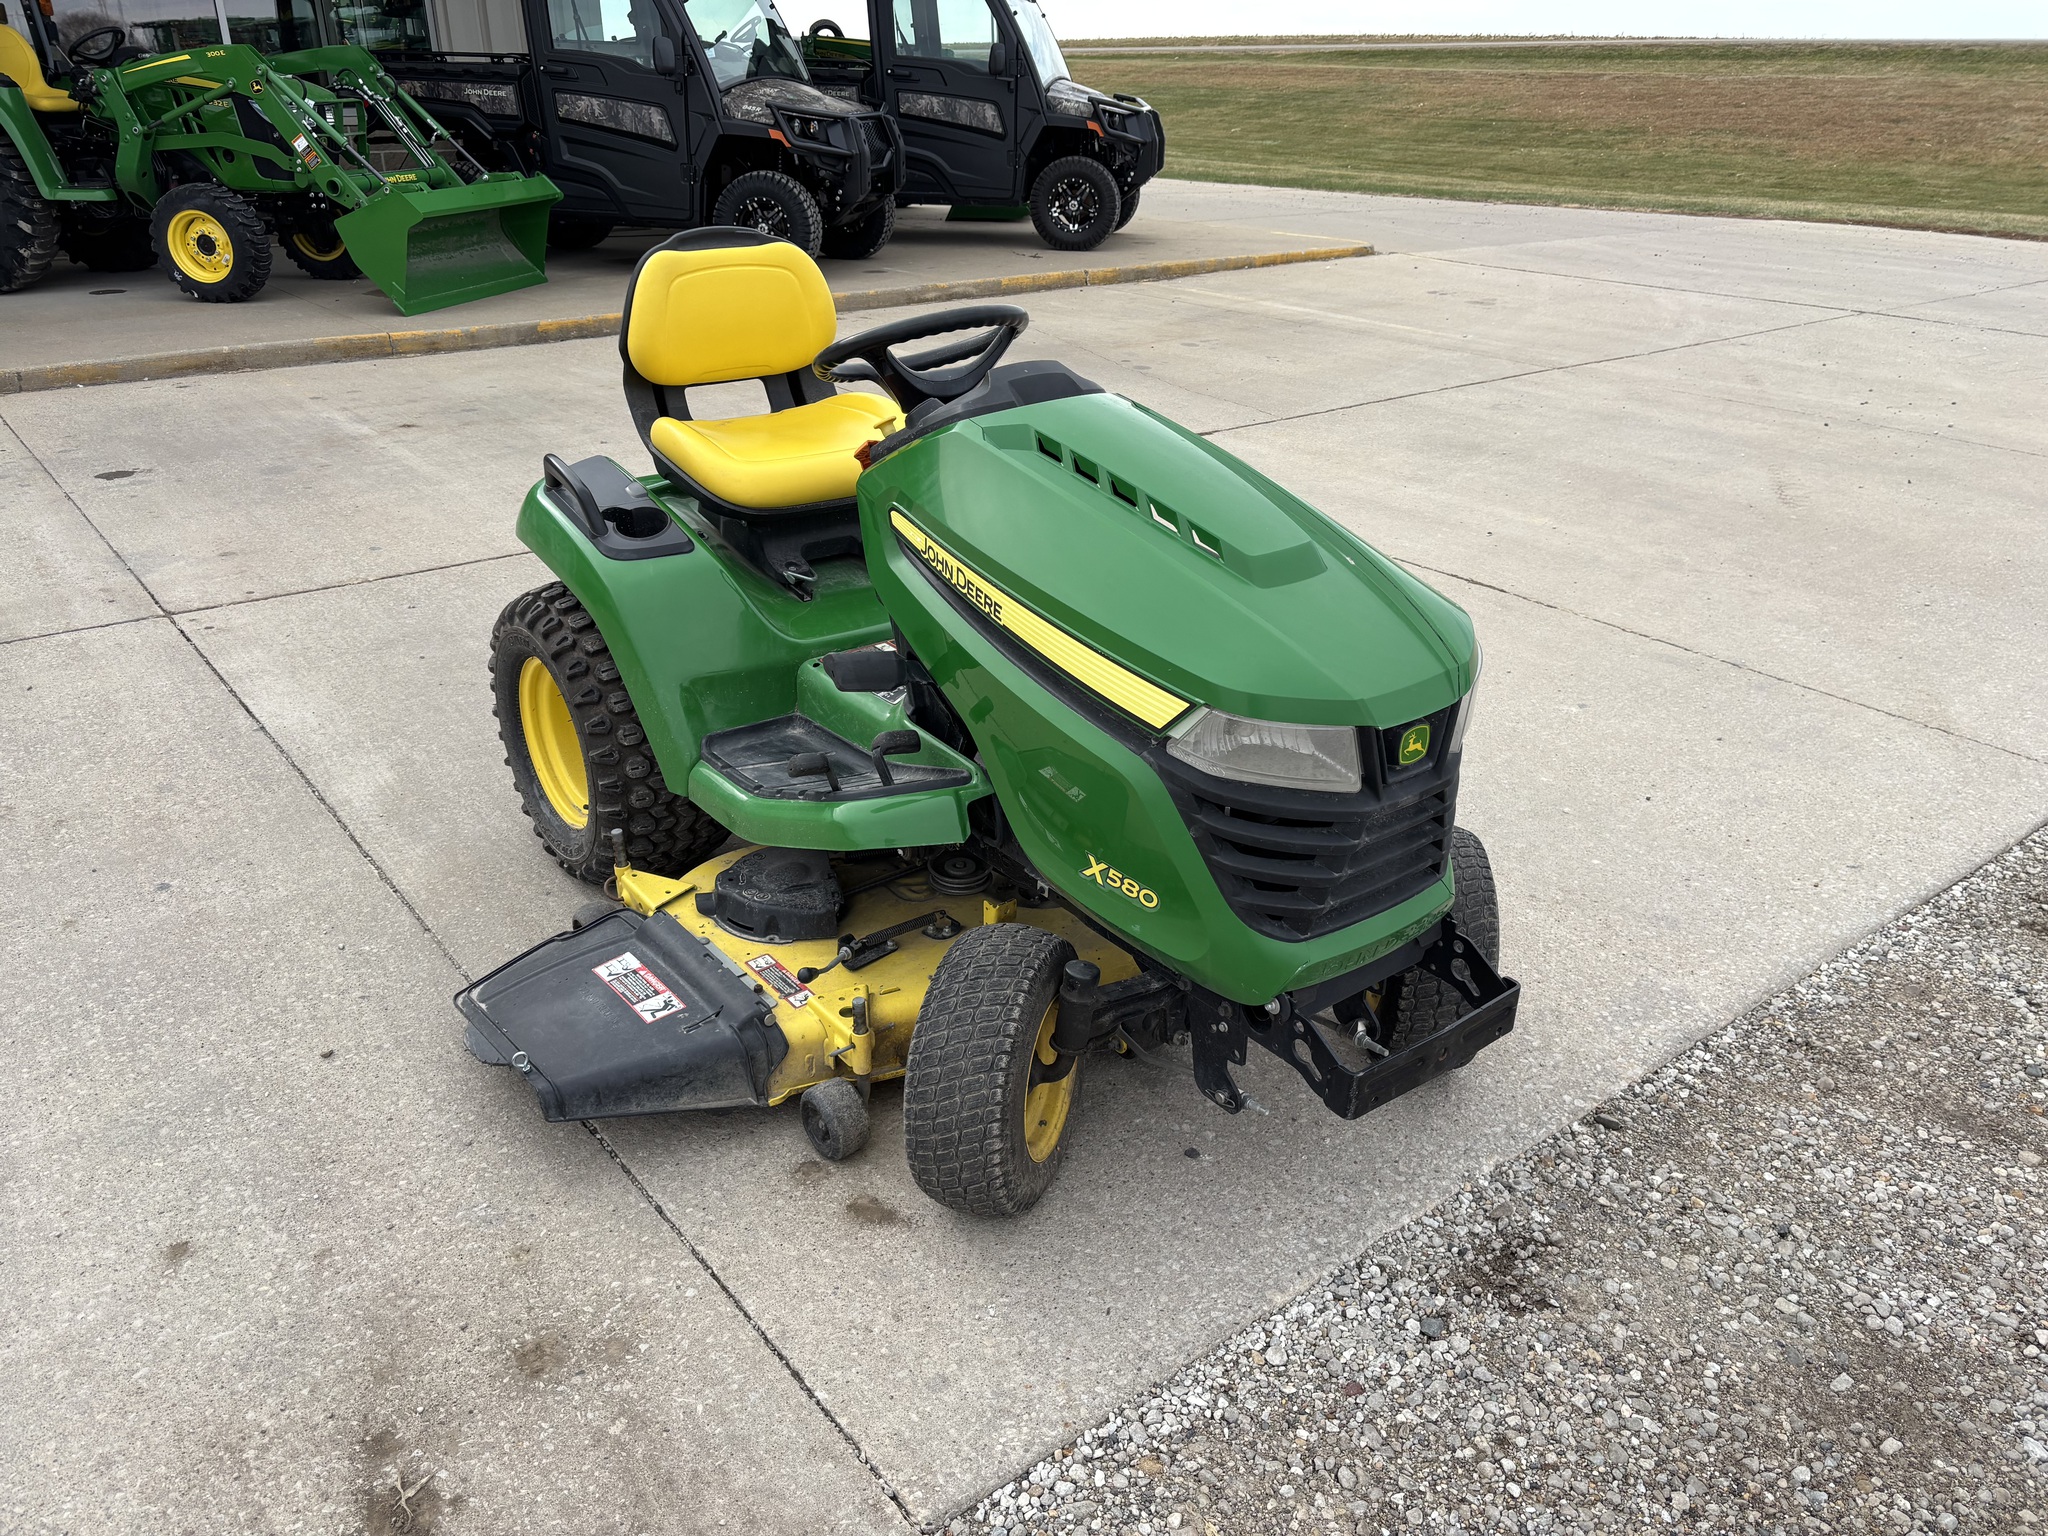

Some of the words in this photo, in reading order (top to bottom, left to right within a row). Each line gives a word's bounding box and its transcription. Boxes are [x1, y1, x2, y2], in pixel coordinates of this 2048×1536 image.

[483, 89, 507, 97] DEERE
[395, 174, 418, 182] DEERE
[920, 537, 954, 582] JOHN
[956, 566, 1003, 624] DEERE
[1080, 853, 1160, 909] X580
